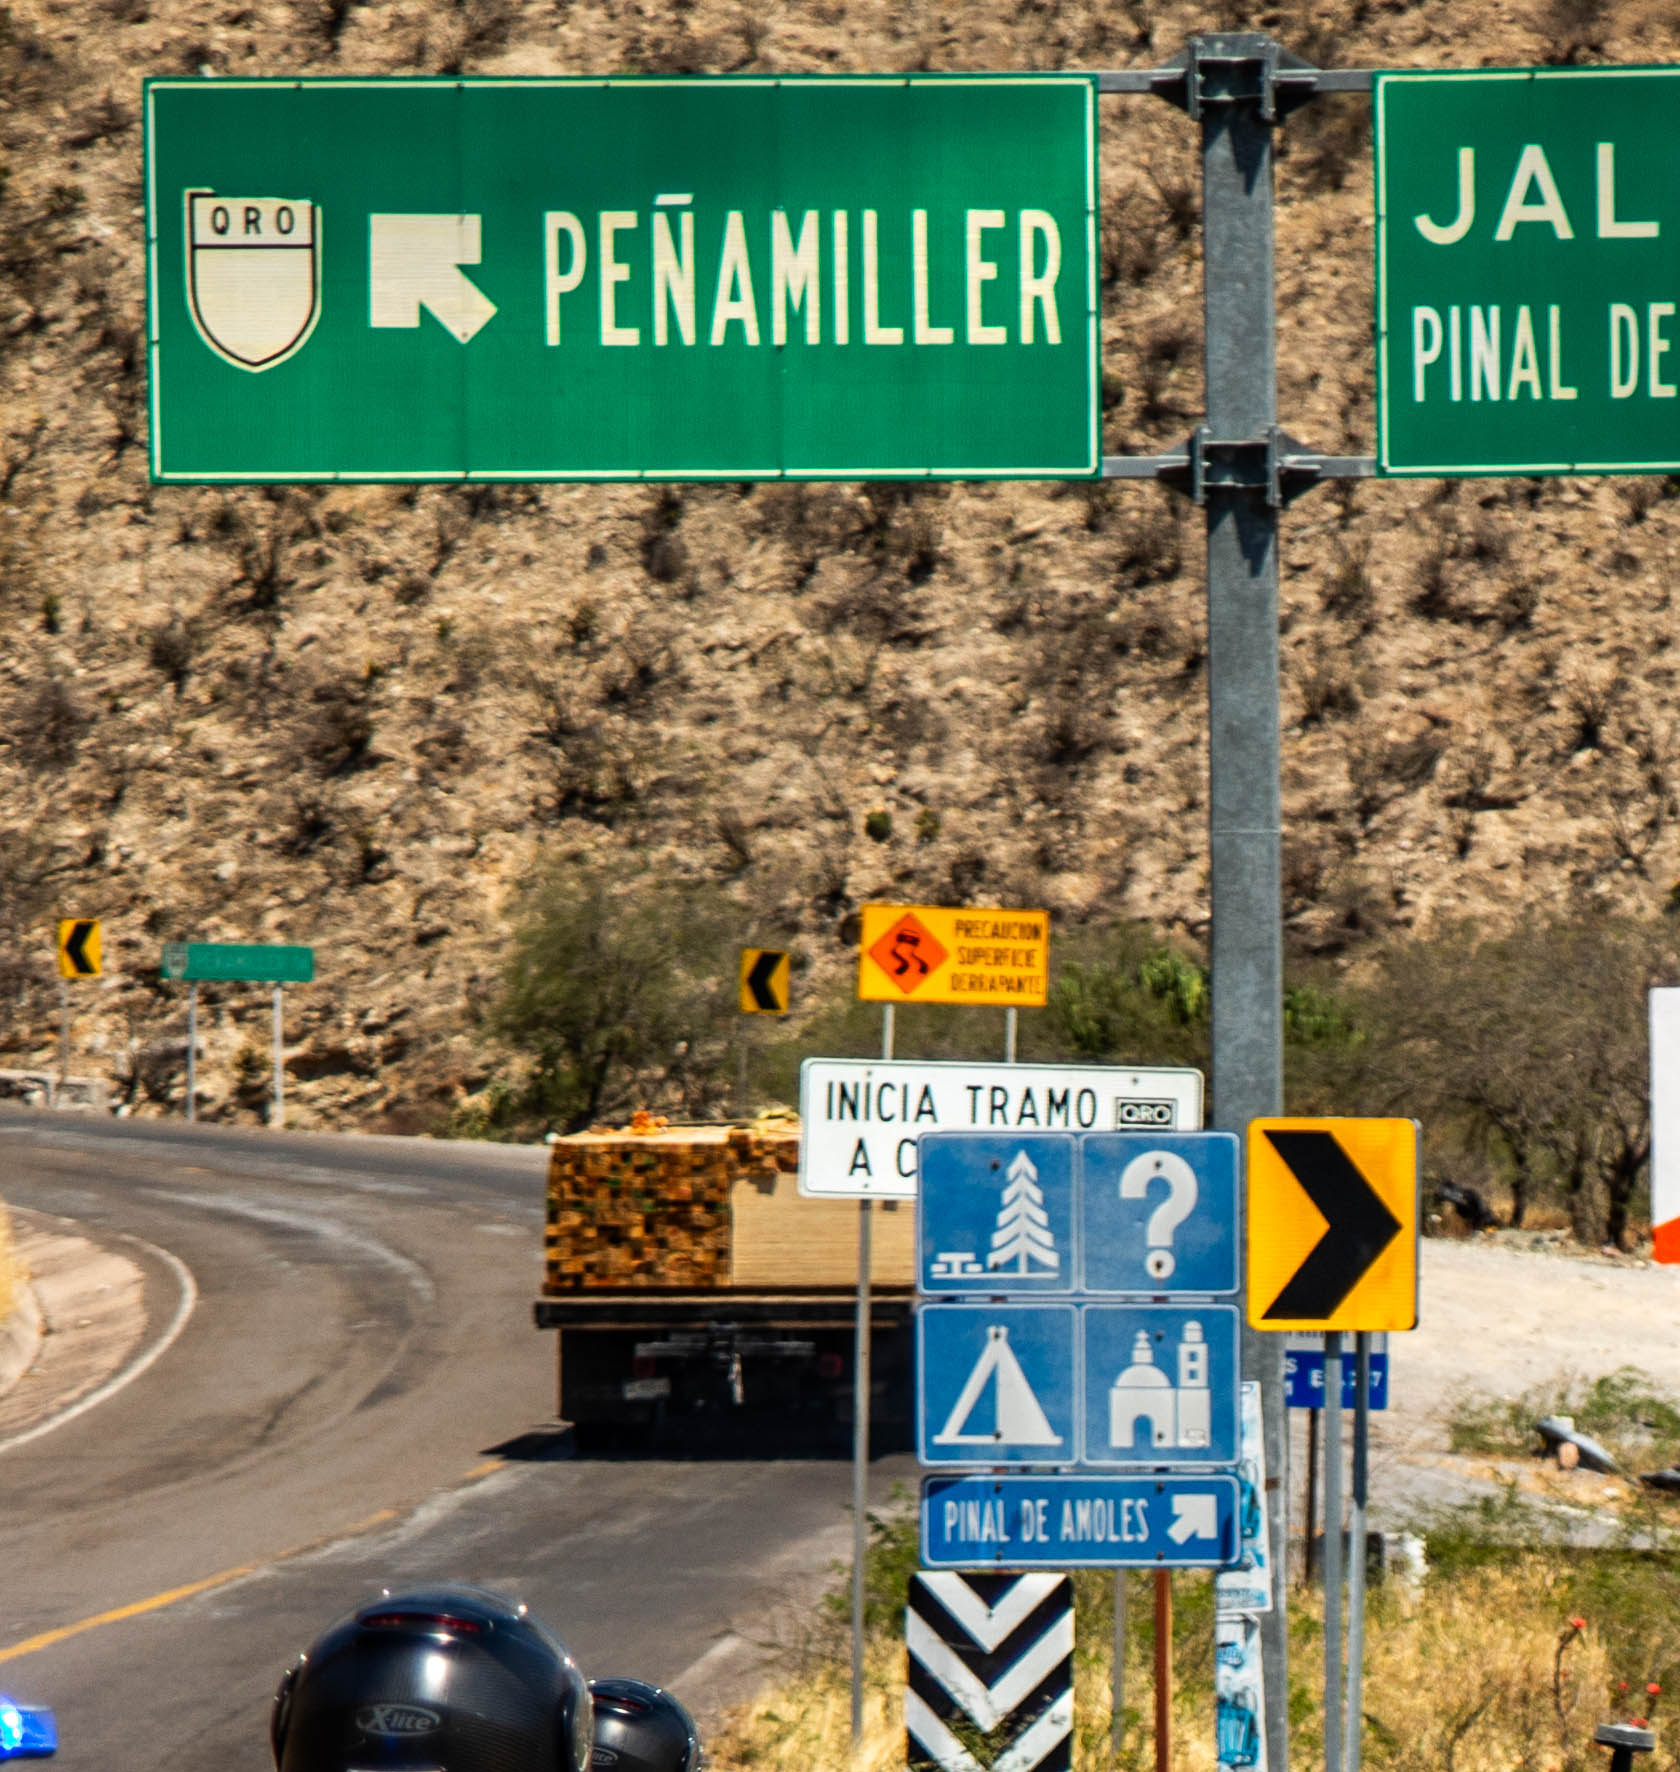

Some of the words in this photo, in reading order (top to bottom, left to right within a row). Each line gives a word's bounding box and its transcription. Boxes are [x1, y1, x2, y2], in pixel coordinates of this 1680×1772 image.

[210, 205, 295, 236] QRO
[543, 193, 1062, 346] PEÑAMILLER
[1412, 304, 1578, 402] PINAL
[1609, 301, 1677, 399] DE
[827, 1081, 939, 1124] INICIA
[967, 1085, 1098, 1128] TRAMO
[849, 1137, 873, 1177] A
[944, 1499, 1011, 1543] PINAL
[1021, 1499, 1050, 1542] DE
[1060, 1498, 1150, 1543] AMOLES
